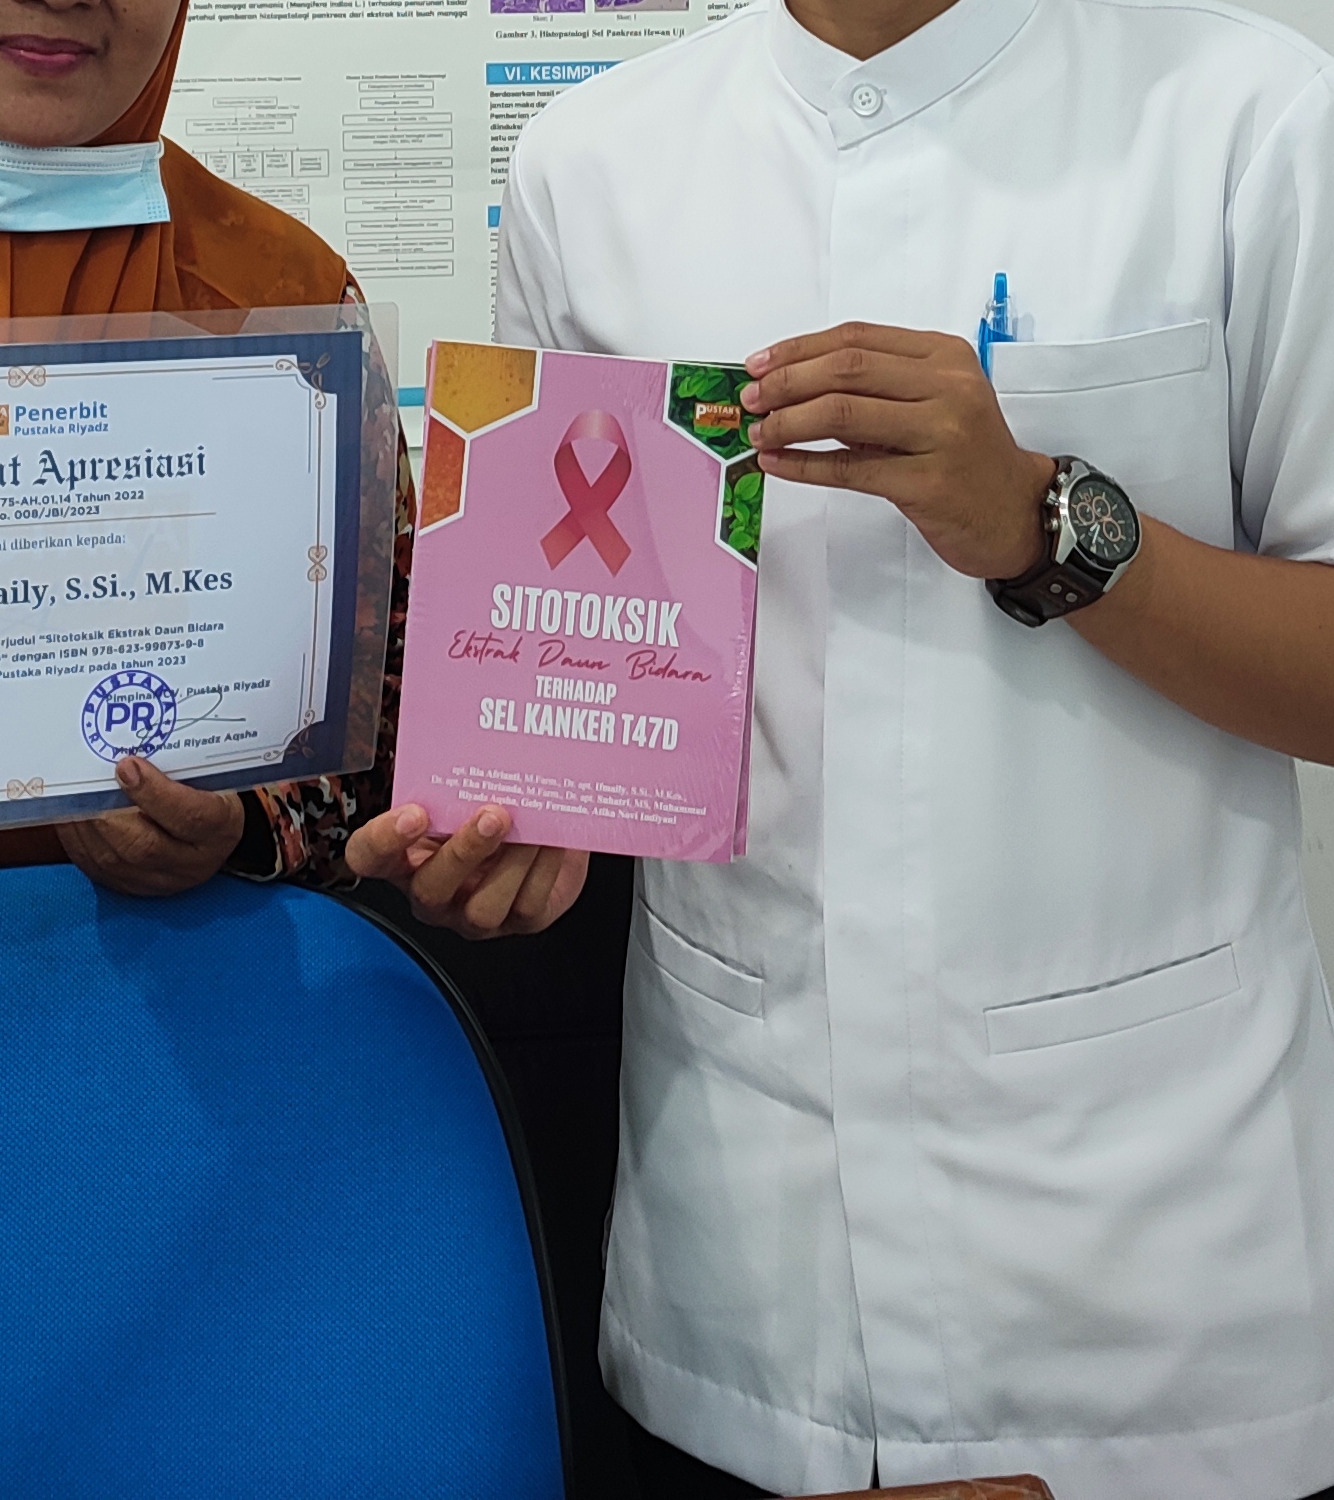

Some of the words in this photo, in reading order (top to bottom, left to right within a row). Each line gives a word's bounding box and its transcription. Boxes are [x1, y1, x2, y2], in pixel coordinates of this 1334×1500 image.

[505, 66, 526, 81] VI.
[530, 65, 607, 80] KESIMPU
[15, 401, 108, 423] Penerbit
[14, 424, 65, 436] Pustaka
[68, 421, 109, 436] Riyadz
[32, 445, 208, 492] Apresiasi
[75, 492, 111, 504] Tahun
[114, 490, 145, 501] 2022
[10, 534, 73, 550] diberikan
[77, 532, 127, 548] kepada:
[64, 575, 139, 604] S.Si.,
[144, 568, 233, 597] M.Kes
[491, 583, 683, 648] SITOTOKSIK
[108, 628, 151, 639] Ekstrak
[155, 625, 184, 635] Daun
[187, 622, 224, 633] Bidara
[11, 651, 55, 664] dengan
[59, 648, 88, 659] ISBN
[45, 664, 85, 676] Riyadz
[88, 662, 117, 674] pada
[121, 658, 154, 669] tahun
[157, 655, 187, 667] 2023
[448, 630, 521, 664] Ekstrak
[537, 639, 610, 672] Daun
[625, 650, 713, 684] Bidara
[84, 672, 175, 714] PUSTAKA
[187, 685, 230, 697] Pustaka
[233, 679, 271, 692] Riyadz
[535, 675, 617, 705] TERHADAP
[105, 702, 155, 732] PR
[479, 697, 519, 732] SEL
[523, 701, 616, 744] KANKER
[621, 712, 679, 752] T47D
[183, 736, 221, 748] Riyadz
[225, 729, 259, 744] Aqsha
